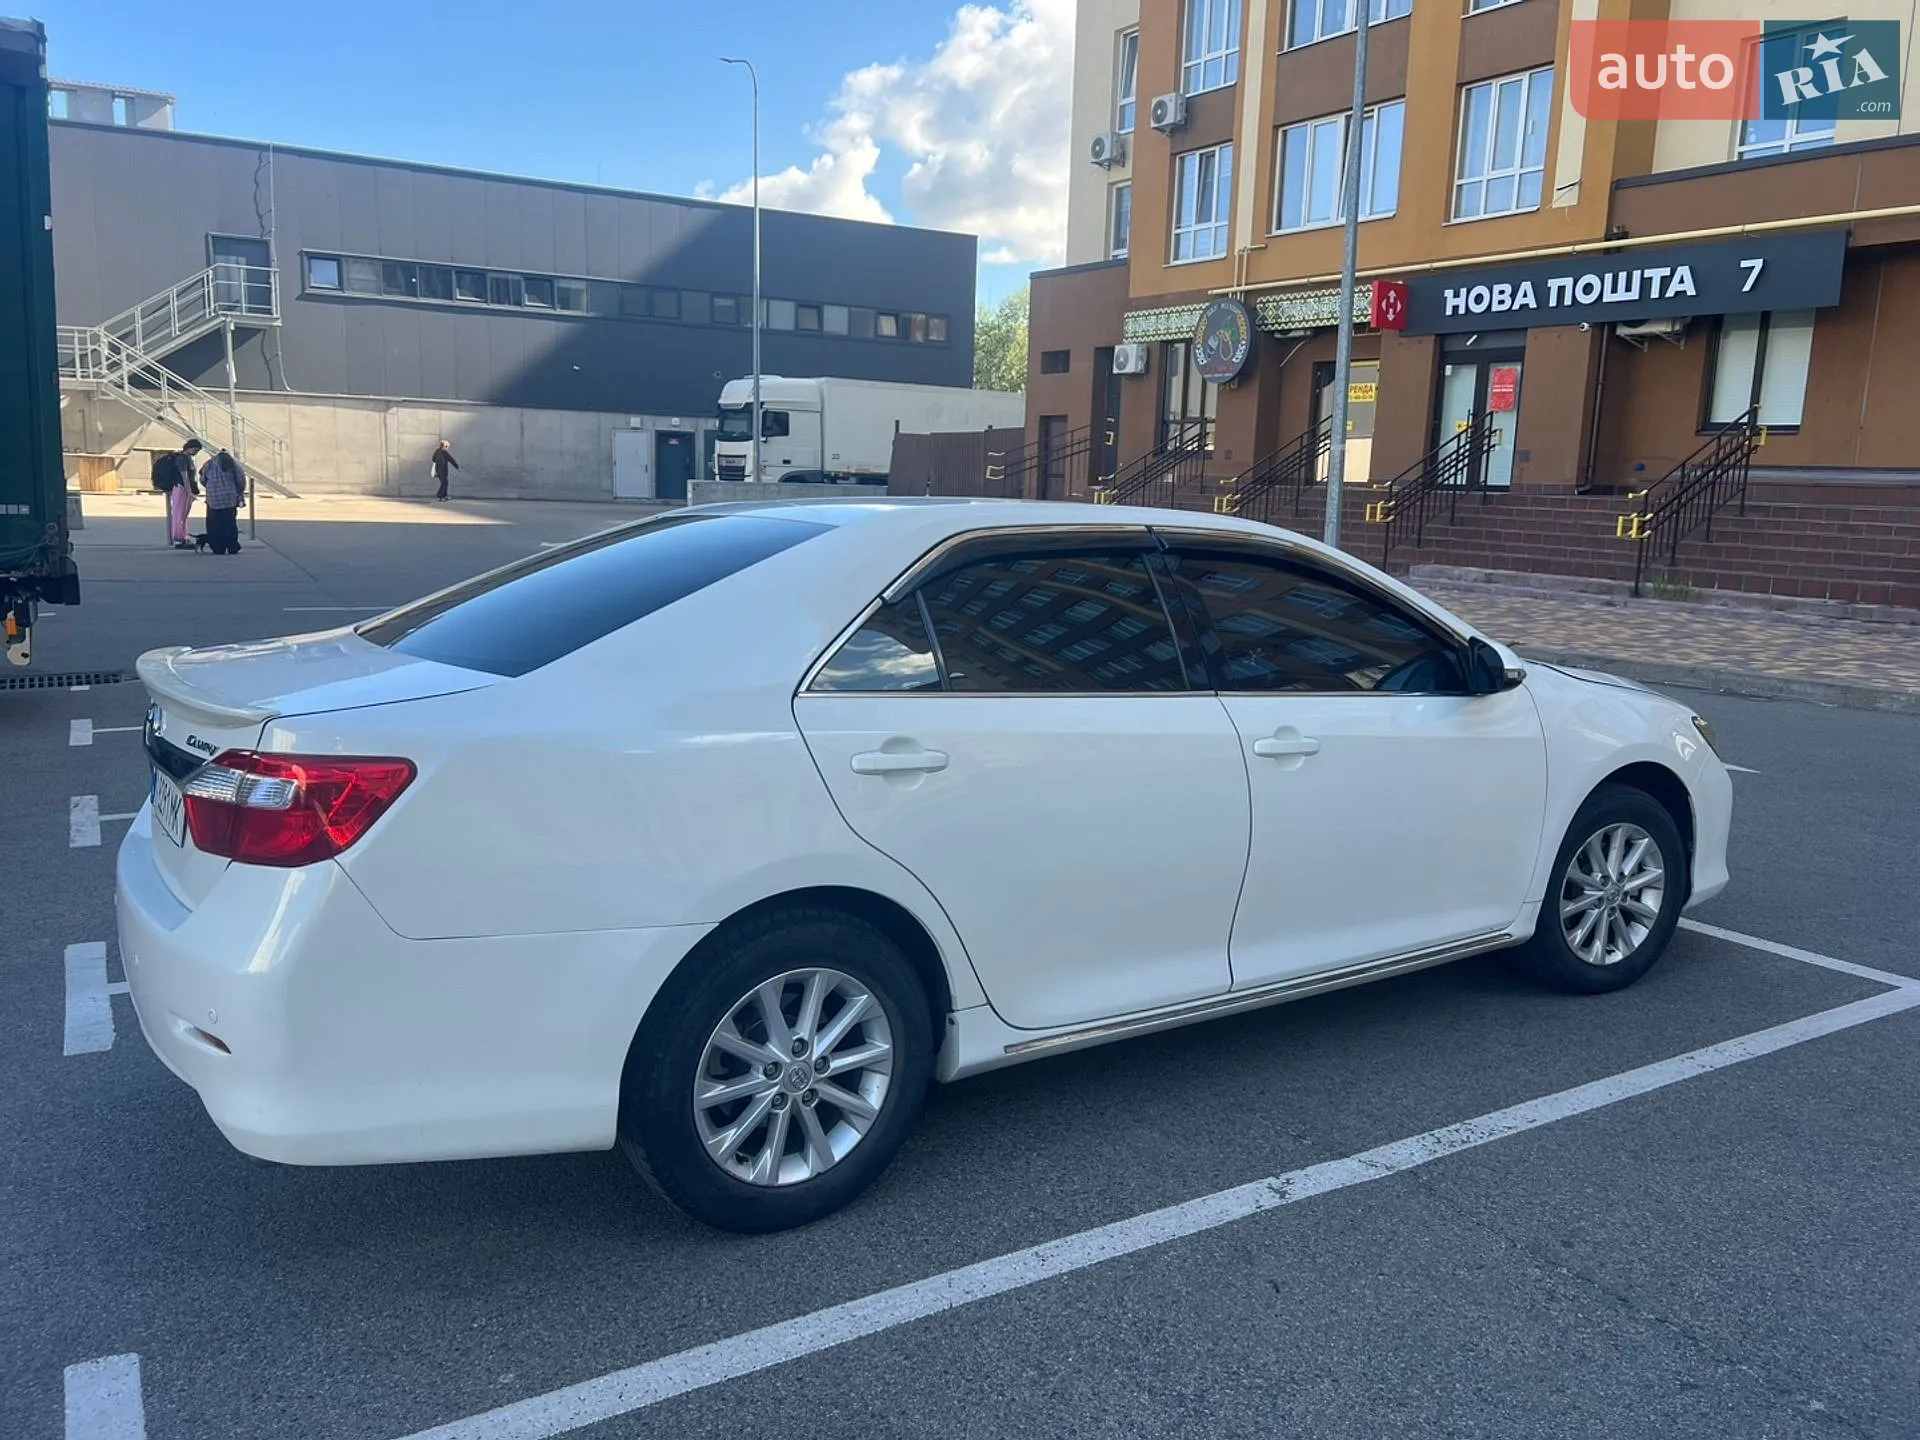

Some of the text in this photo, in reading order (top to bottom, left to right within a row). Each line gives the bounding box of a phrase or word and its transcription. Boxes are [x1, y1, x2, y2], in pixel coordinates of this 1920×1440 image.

[1444, 258, 1764, 316] НОВА ПОШТА 7
[1349, 384, 1373, 394] РЕНДА
